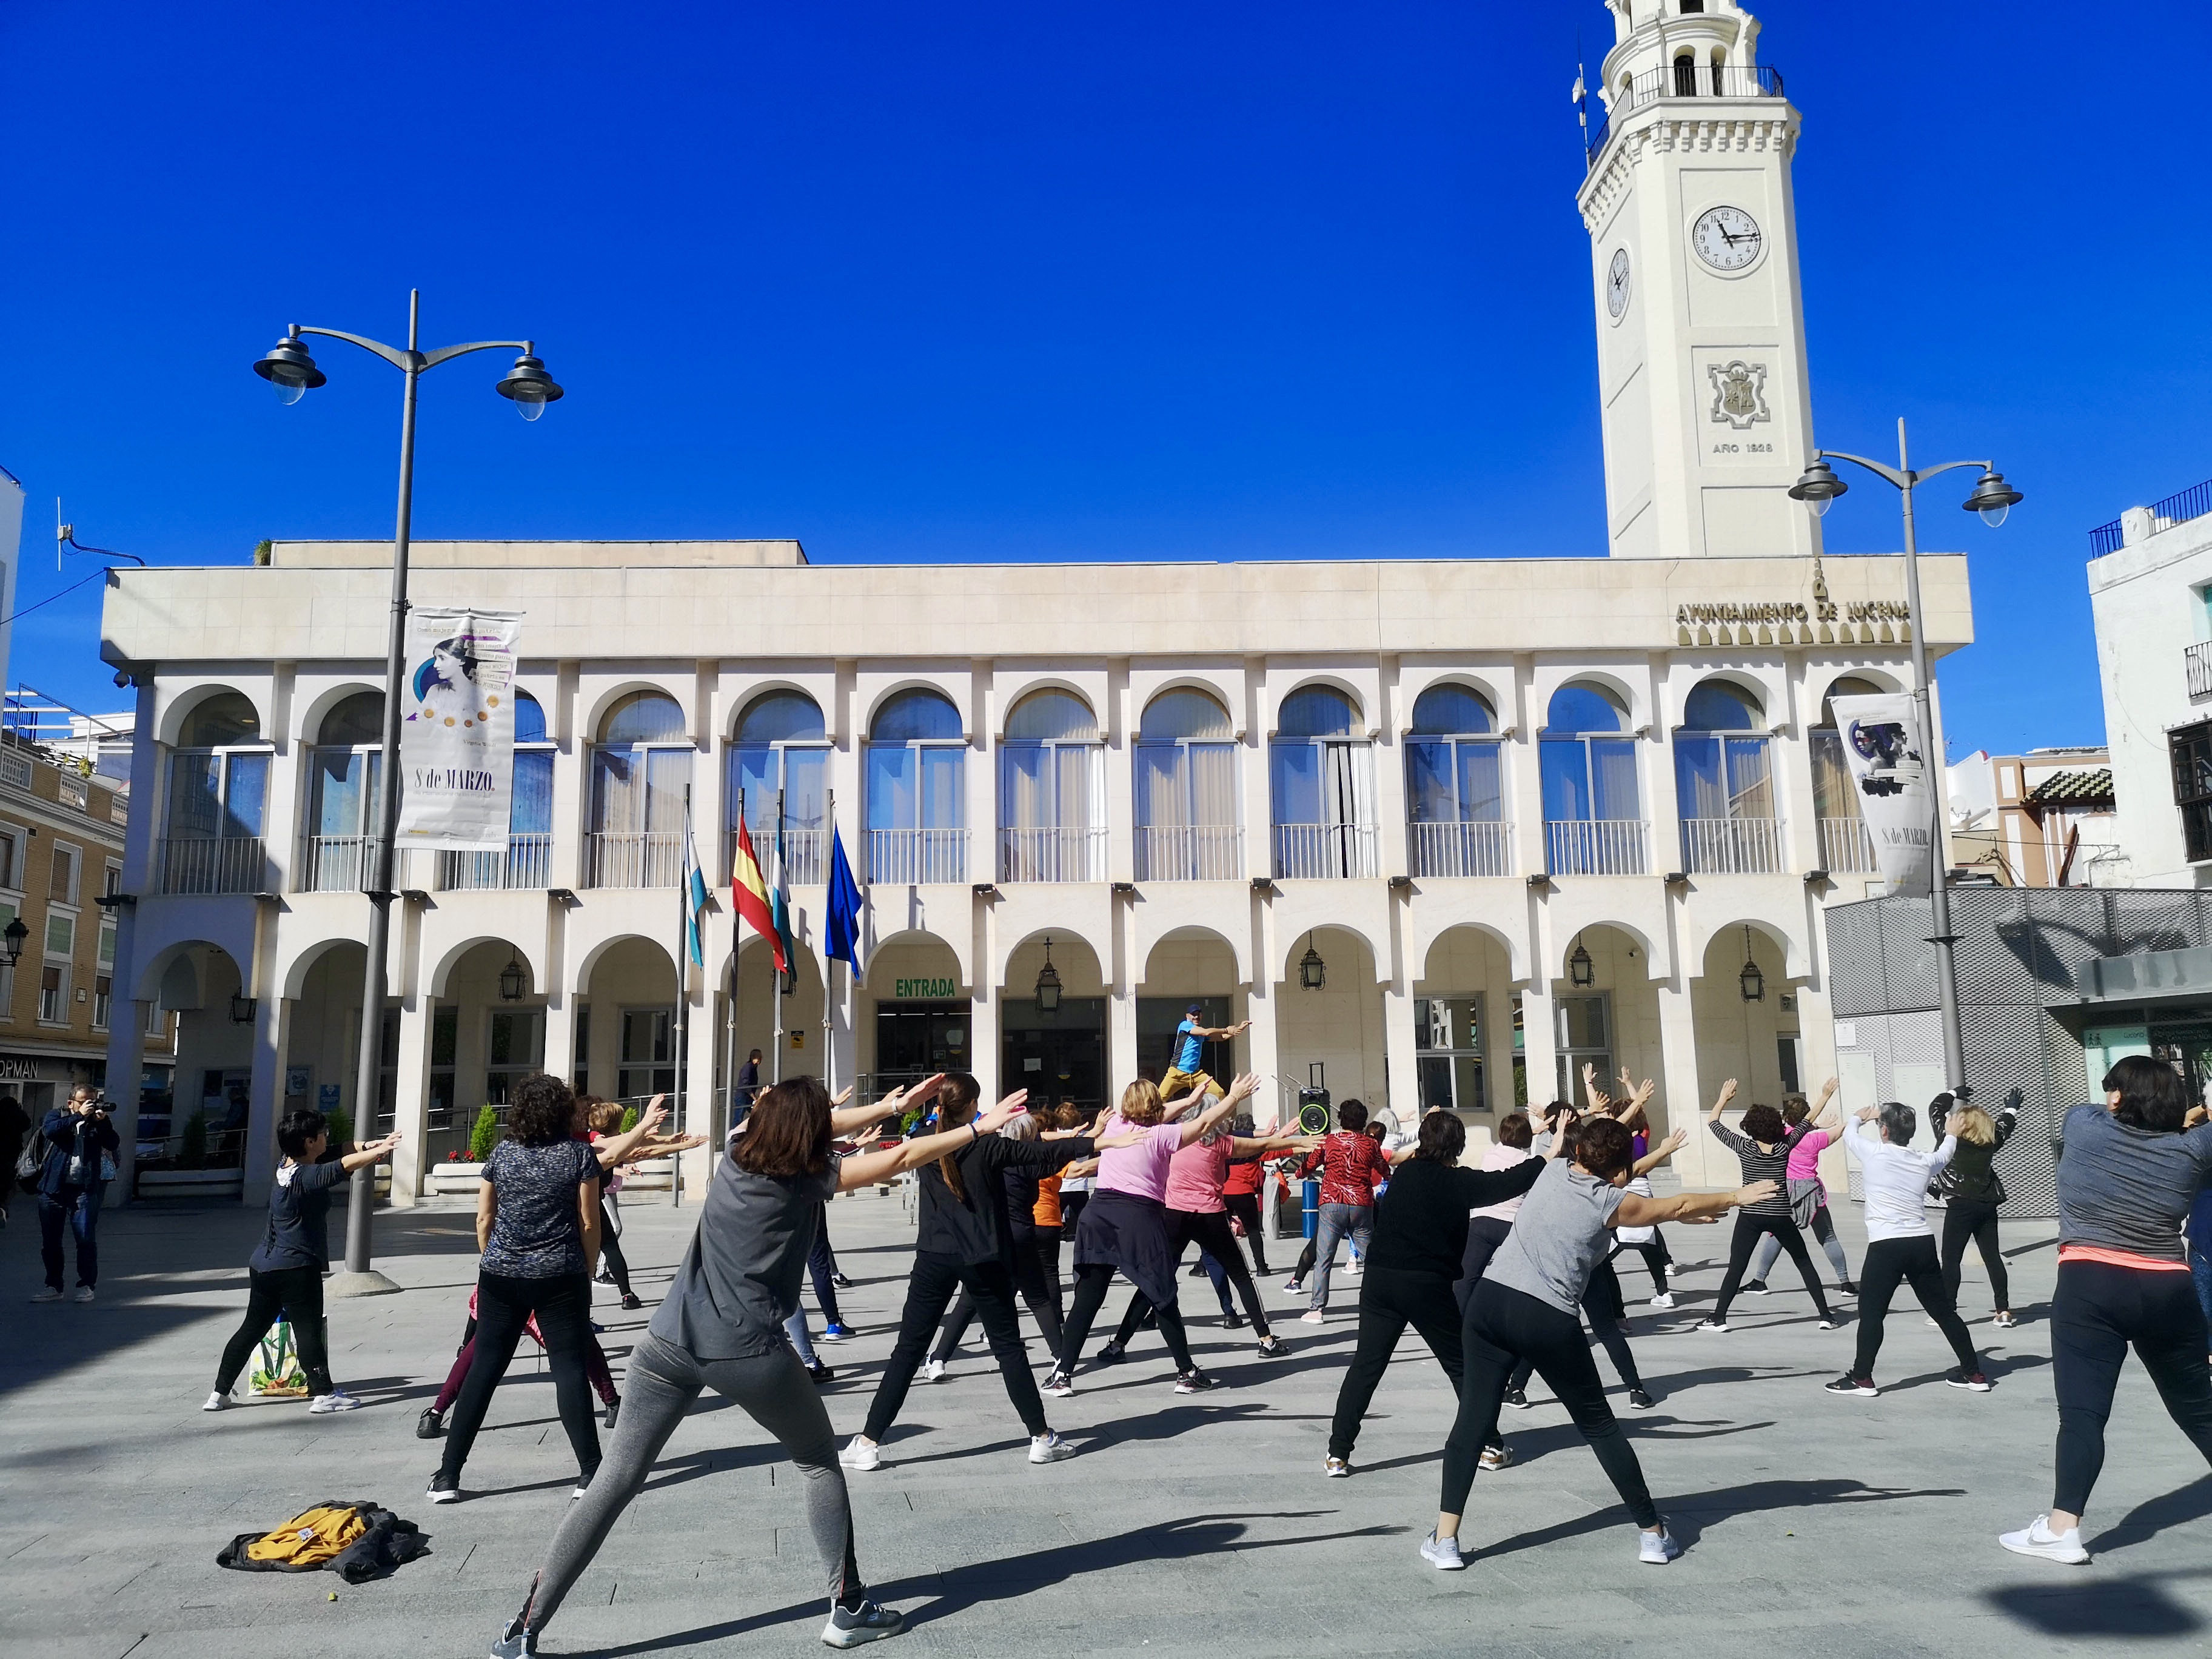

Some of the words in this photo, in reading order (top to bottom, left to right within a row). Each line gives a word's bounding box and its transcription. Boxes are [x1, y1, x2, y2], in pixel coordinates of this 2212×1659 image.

[1711, 215, 1717, 223] 11
[1721, 212, 1730, 221] 12
[1736, 215, 1739, 223] 1
[1701, 223, 1709, 232] 10
[1743, 223, 1749, 232] 2
[1700, 235, 1705, 243] 9
[1704, 246, 1709, 254] 8
[1714, 254, 1718, 263] 7
[1726, 256, 1731, 266] 6
[1713, 443, 1739, 454] AÑO
[1746, 443, 1773, 453] 1928
[1676, 602, 1807, 621] AYUNTAMIENTO
[1816, 601, 1837, 618] DE
[1846, 601, 1910, 618] LUCENA
[415, 768, 423, 788] 8
[426, 769, 441, 788] de
[896, 979, 955, 997] ENTRADA
